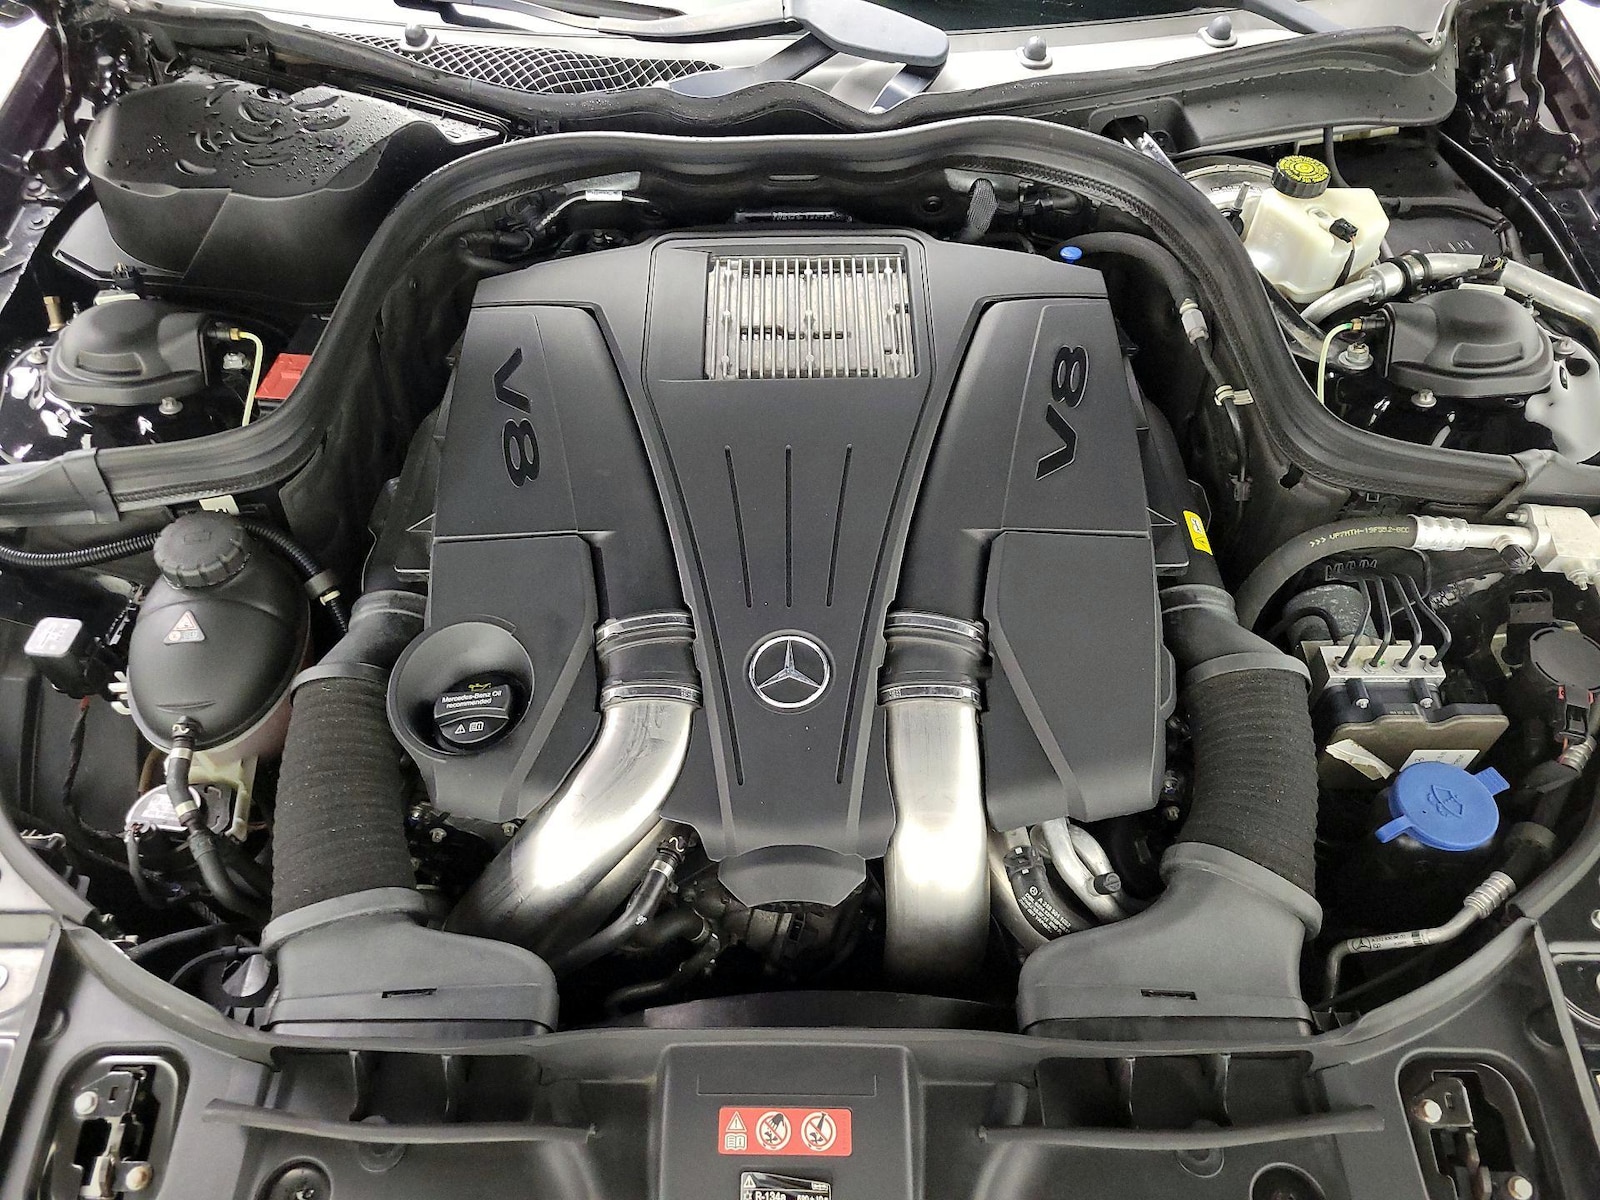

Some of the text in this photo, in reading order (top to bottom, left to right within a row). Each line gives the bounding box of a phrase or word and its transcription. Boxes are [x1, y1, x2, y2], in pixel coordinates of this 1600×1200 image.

[492, 346, 541, 488] V8
[1035, 344, 1089, 481] V8
[441, 692, 491, 703] Mercedes-Benz
[446, 698, 492, 709] recommended
[755, 1190, 787, 1200] R-134a
